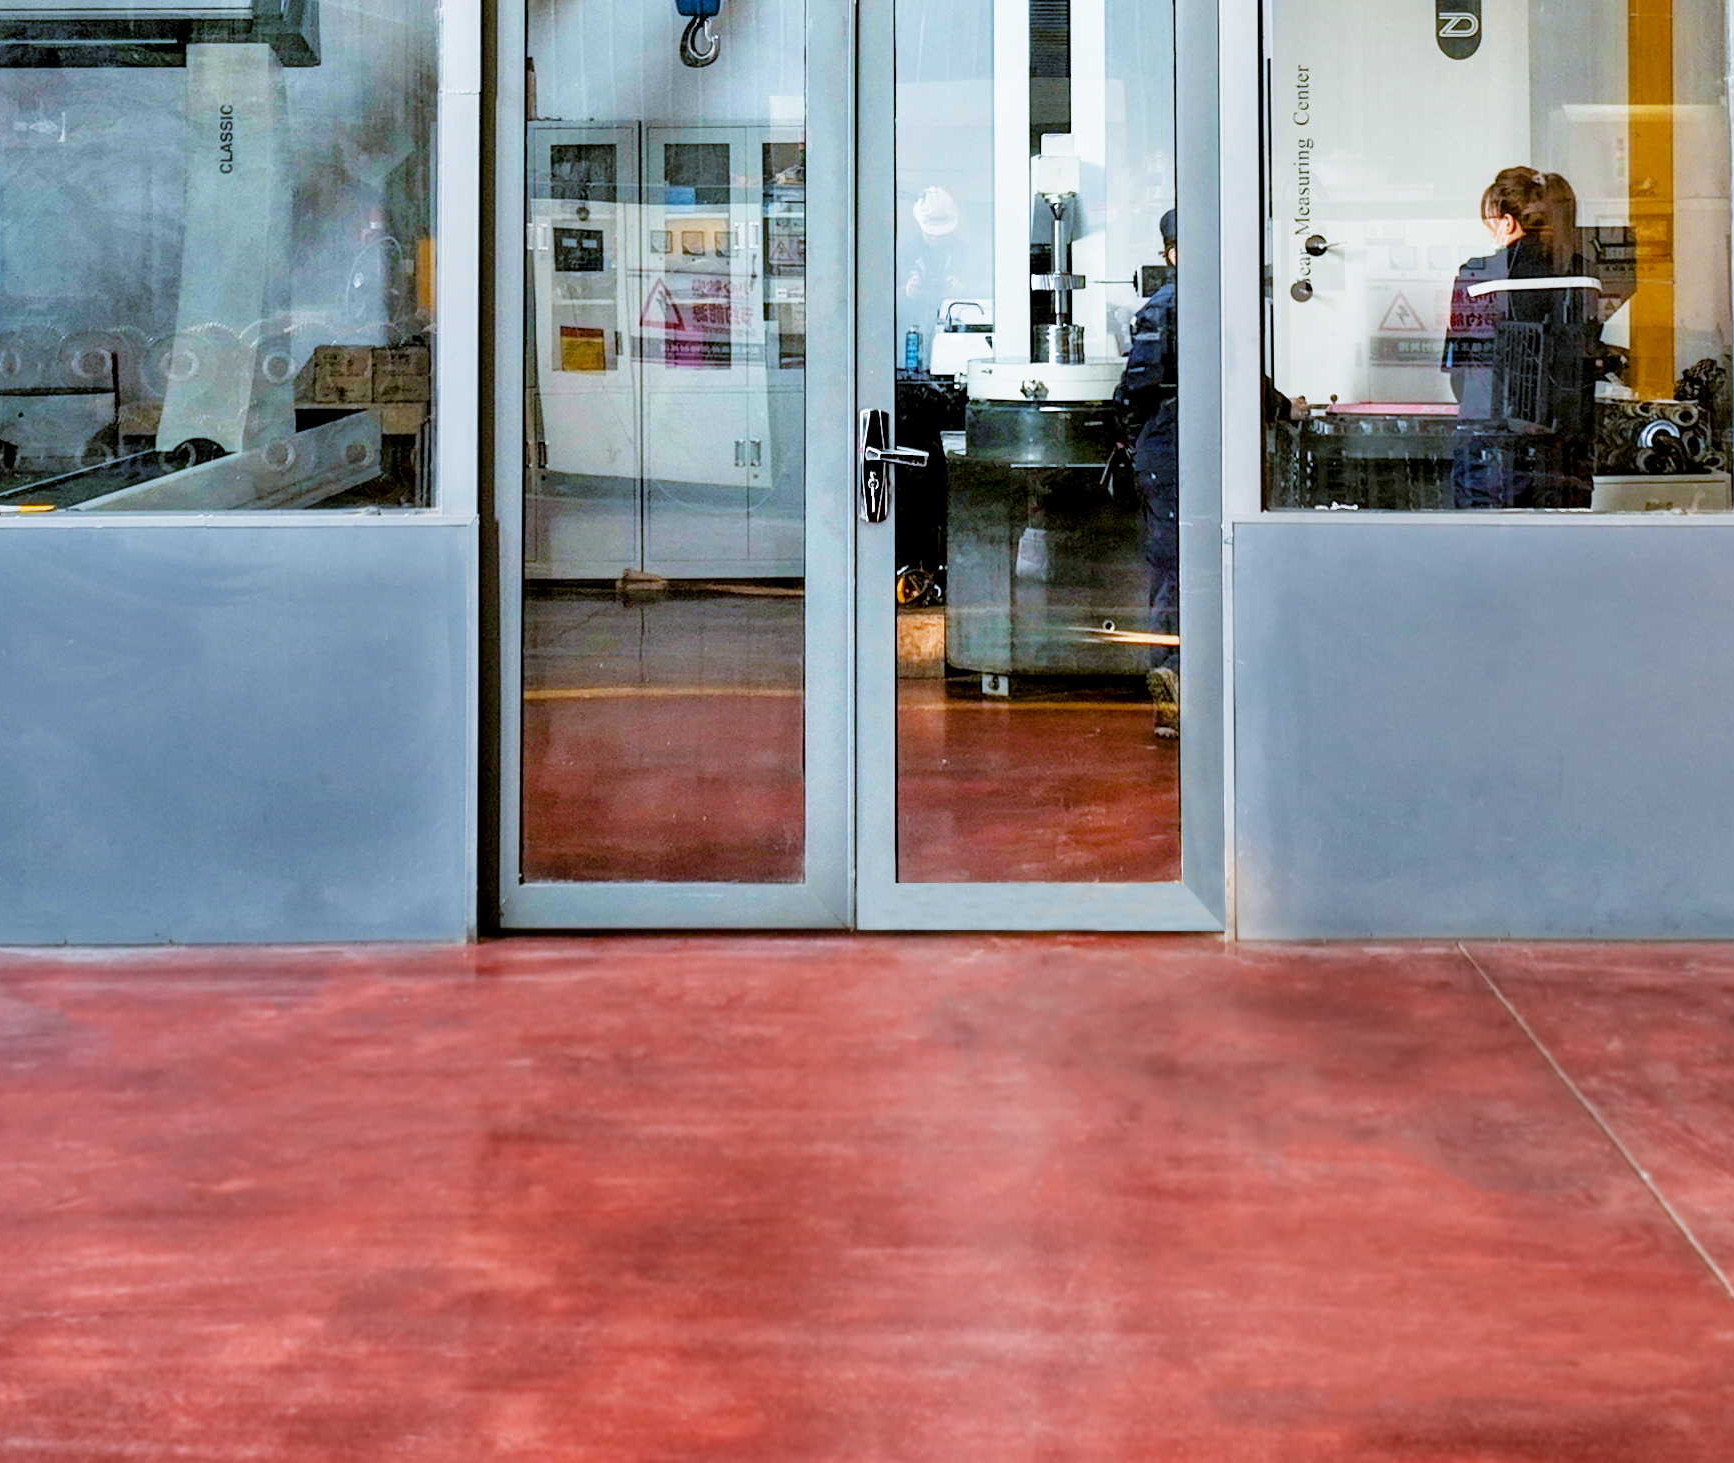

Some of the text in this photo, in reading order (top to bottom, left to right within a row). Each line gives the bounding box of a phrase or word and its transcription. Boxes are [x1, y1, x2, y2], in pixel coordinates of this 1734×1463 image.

[1293, 64, 1310, 126] Center
[219, 105, 234, 174] CLASSIC
[1294, 138, 1314, 235] Measuring
